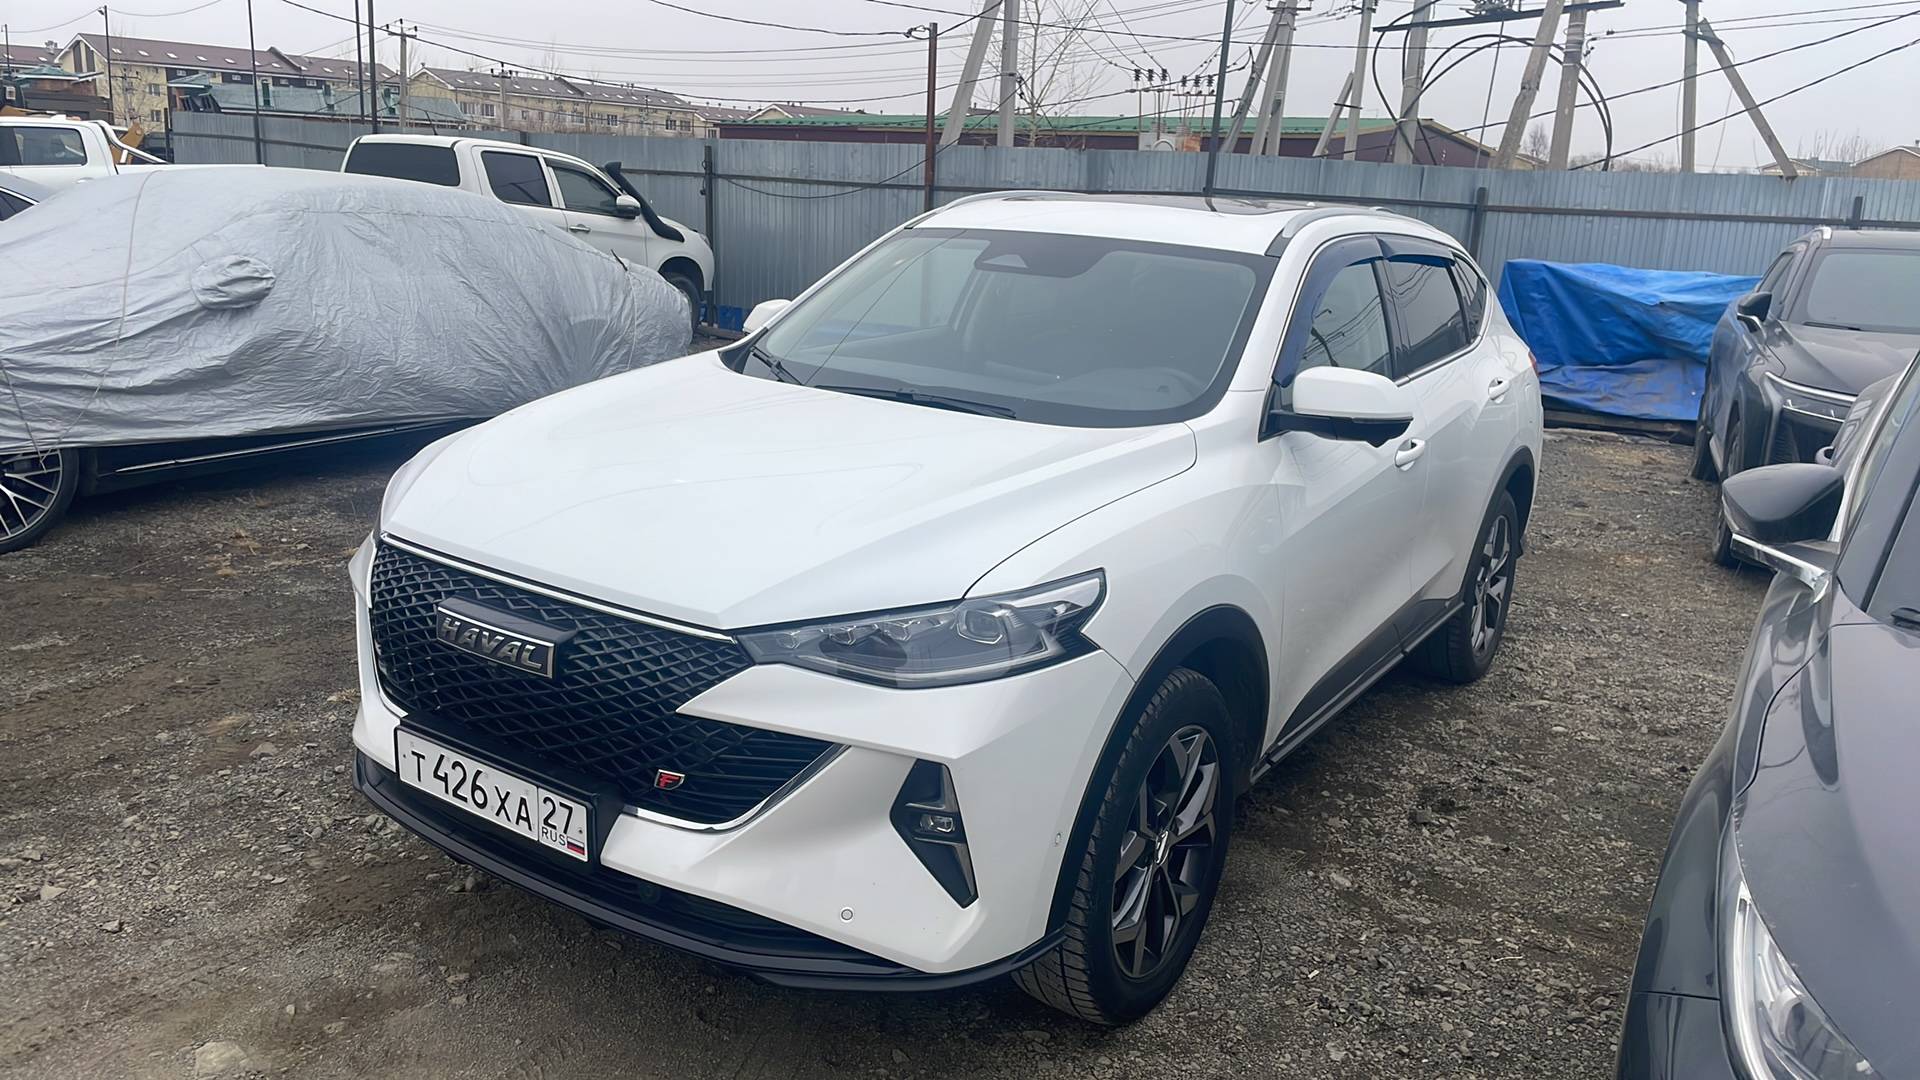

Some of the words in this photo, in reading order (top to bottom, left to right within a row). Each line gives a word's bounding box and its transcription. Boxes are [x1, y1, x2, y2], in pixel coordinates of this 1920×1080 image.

[440, 617, 542, 669] HAVAL
[659, 773, 681, 789] F
[542, 796, 574, 835] 27
[541, 826, 567, 847] RUS
